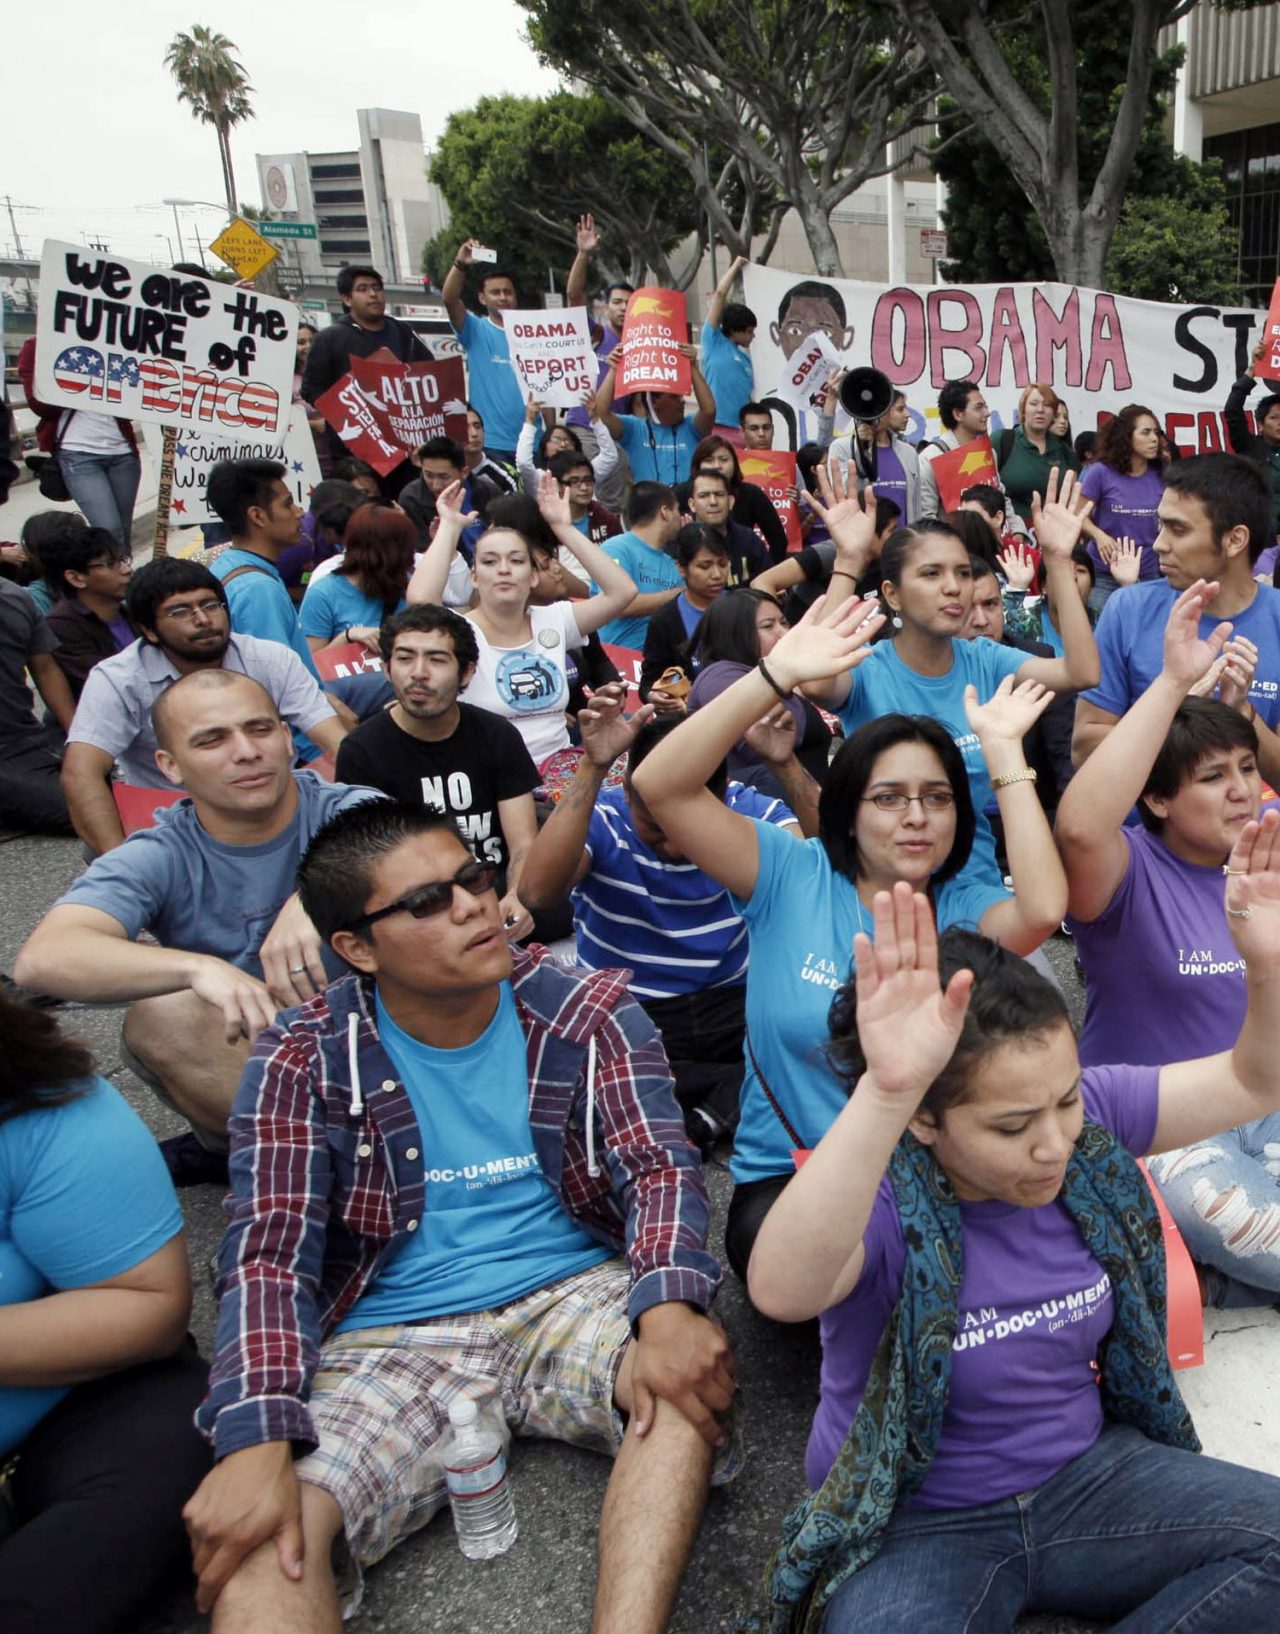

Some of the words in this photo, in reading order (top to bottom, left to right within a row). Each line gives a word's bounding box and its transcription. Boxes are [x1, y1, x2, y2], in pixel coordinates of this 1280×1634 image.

[263, 225, 300, 236] Alameda
[302, 227, 313, 236] St
[222, 237, 242, 245] LEFT
[243, 237, 263, 246] LANE
[248, 247, 266, 255] LEFT
[140, 274, 211, 319] are
[223, 292, 289, 342] the
[54, 290, 188, 362] FUTURE
[208, 336, 257, 376] of
[513, 322, 577, 338] OBAMA
[658, 324, 672, 337] to
[870, 286, 1133, 392] OBAMA
[545, 339, 575, 349] COURT
[622, 336, 679, 355] DUCATION
[662, 351, 678, 366] to
[564, 374, 591, 392] US
[623, 366, 678, 384] DREAM
[381, 374, 440, 406] ALTO
[160, 457, 175, 482] THE
[157, 484, 172, 519] DREAM
[421, 771, 474, 814] NO
[805, 952, 815, 966] I
[1178, 949, 1185, 962] I
[1189, 950, 1213, 962] AM
[963, 1304, 999, 1330] AM
